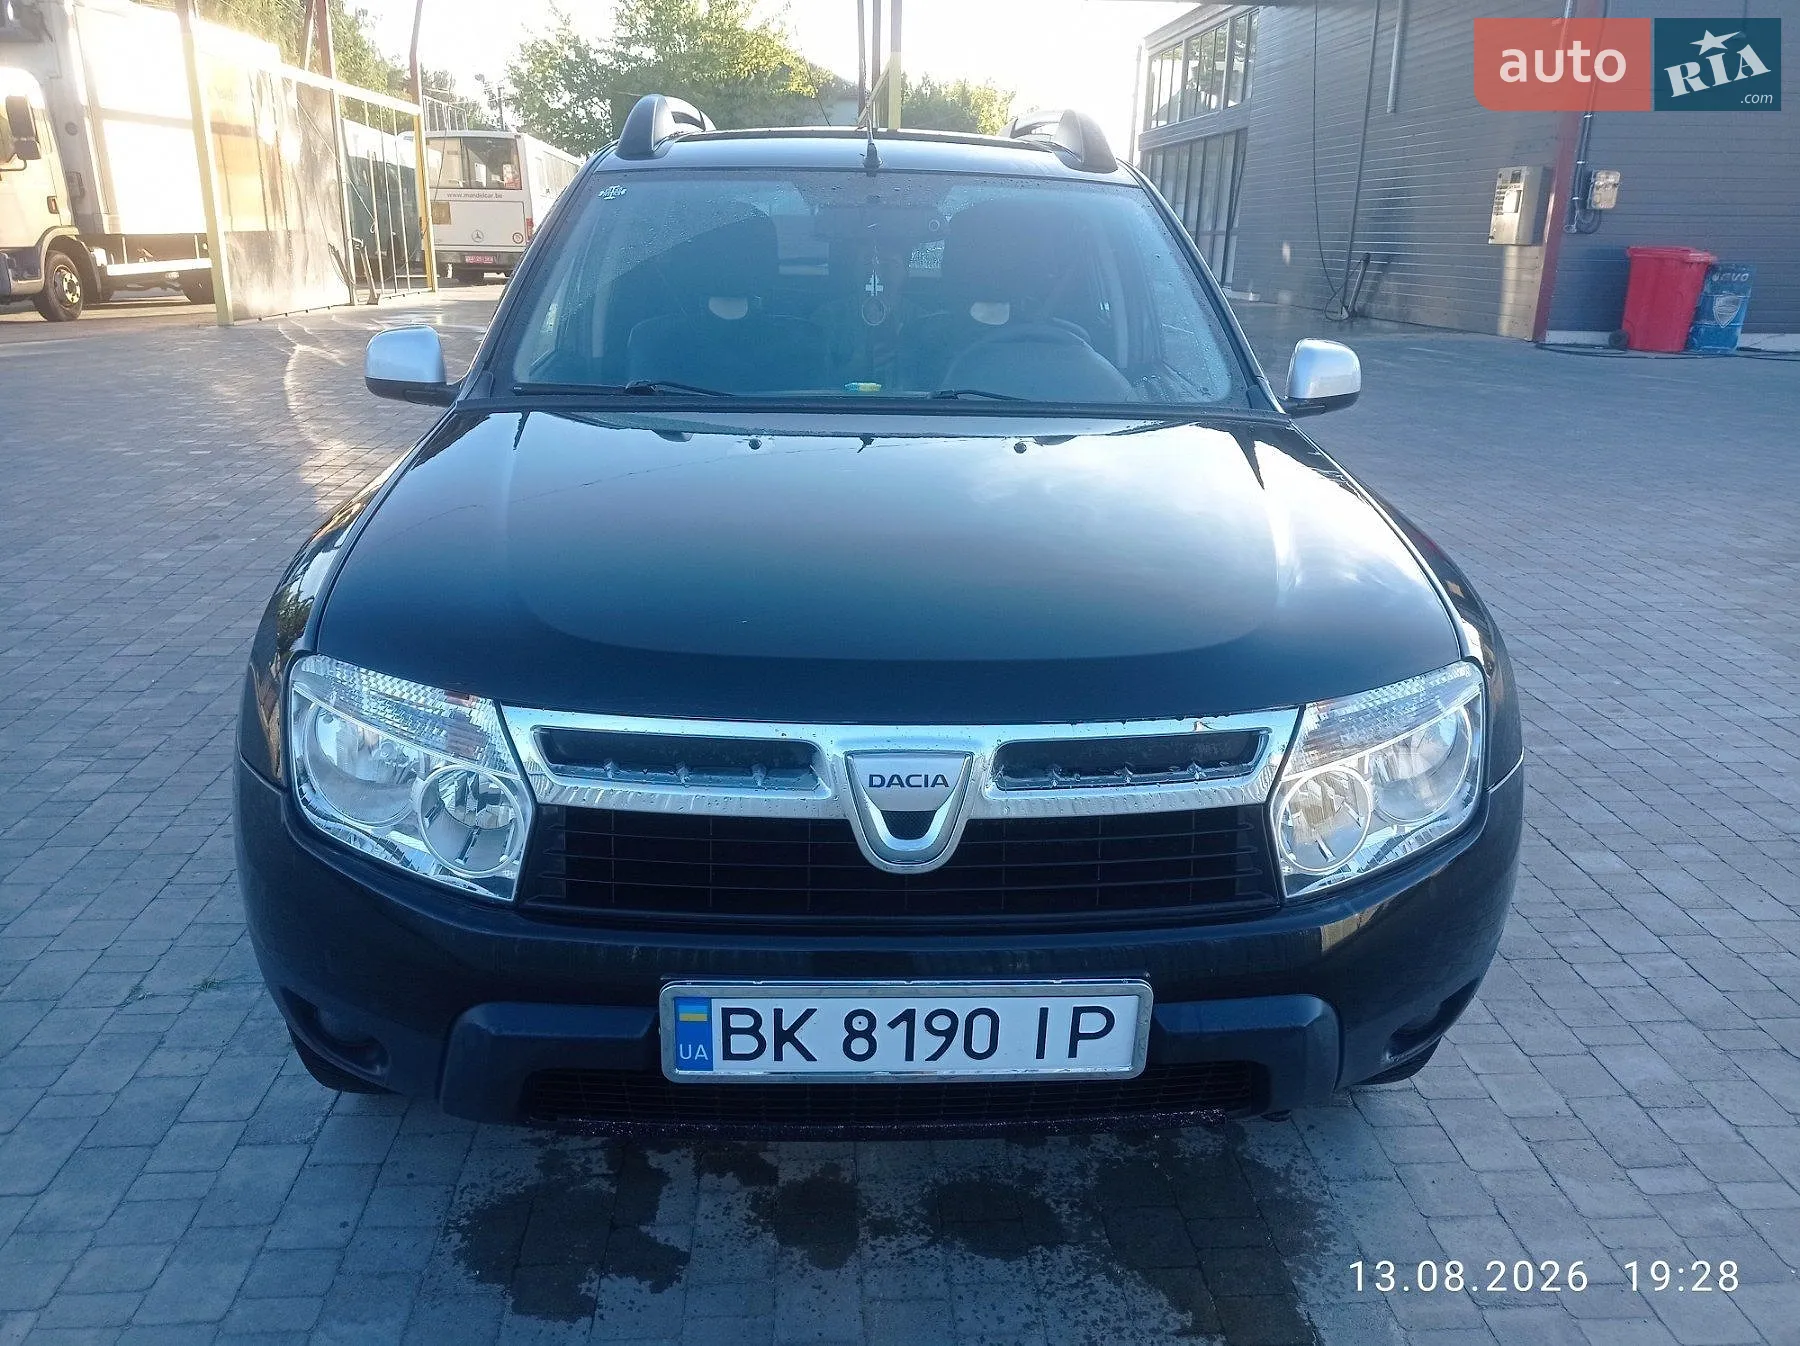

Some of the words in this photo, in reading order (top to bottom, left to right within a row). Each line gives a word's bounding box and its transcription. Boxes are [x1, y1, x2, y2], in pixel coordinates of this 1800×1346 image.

[868, 774, 950, 788] DACIA
[721, 1007, 818, 1062] BK
[843, 1006, 1000, 1062] 8190
[1035, 1006, 1116, 1060] IP
[679, 1043, 709, 1060] UA
